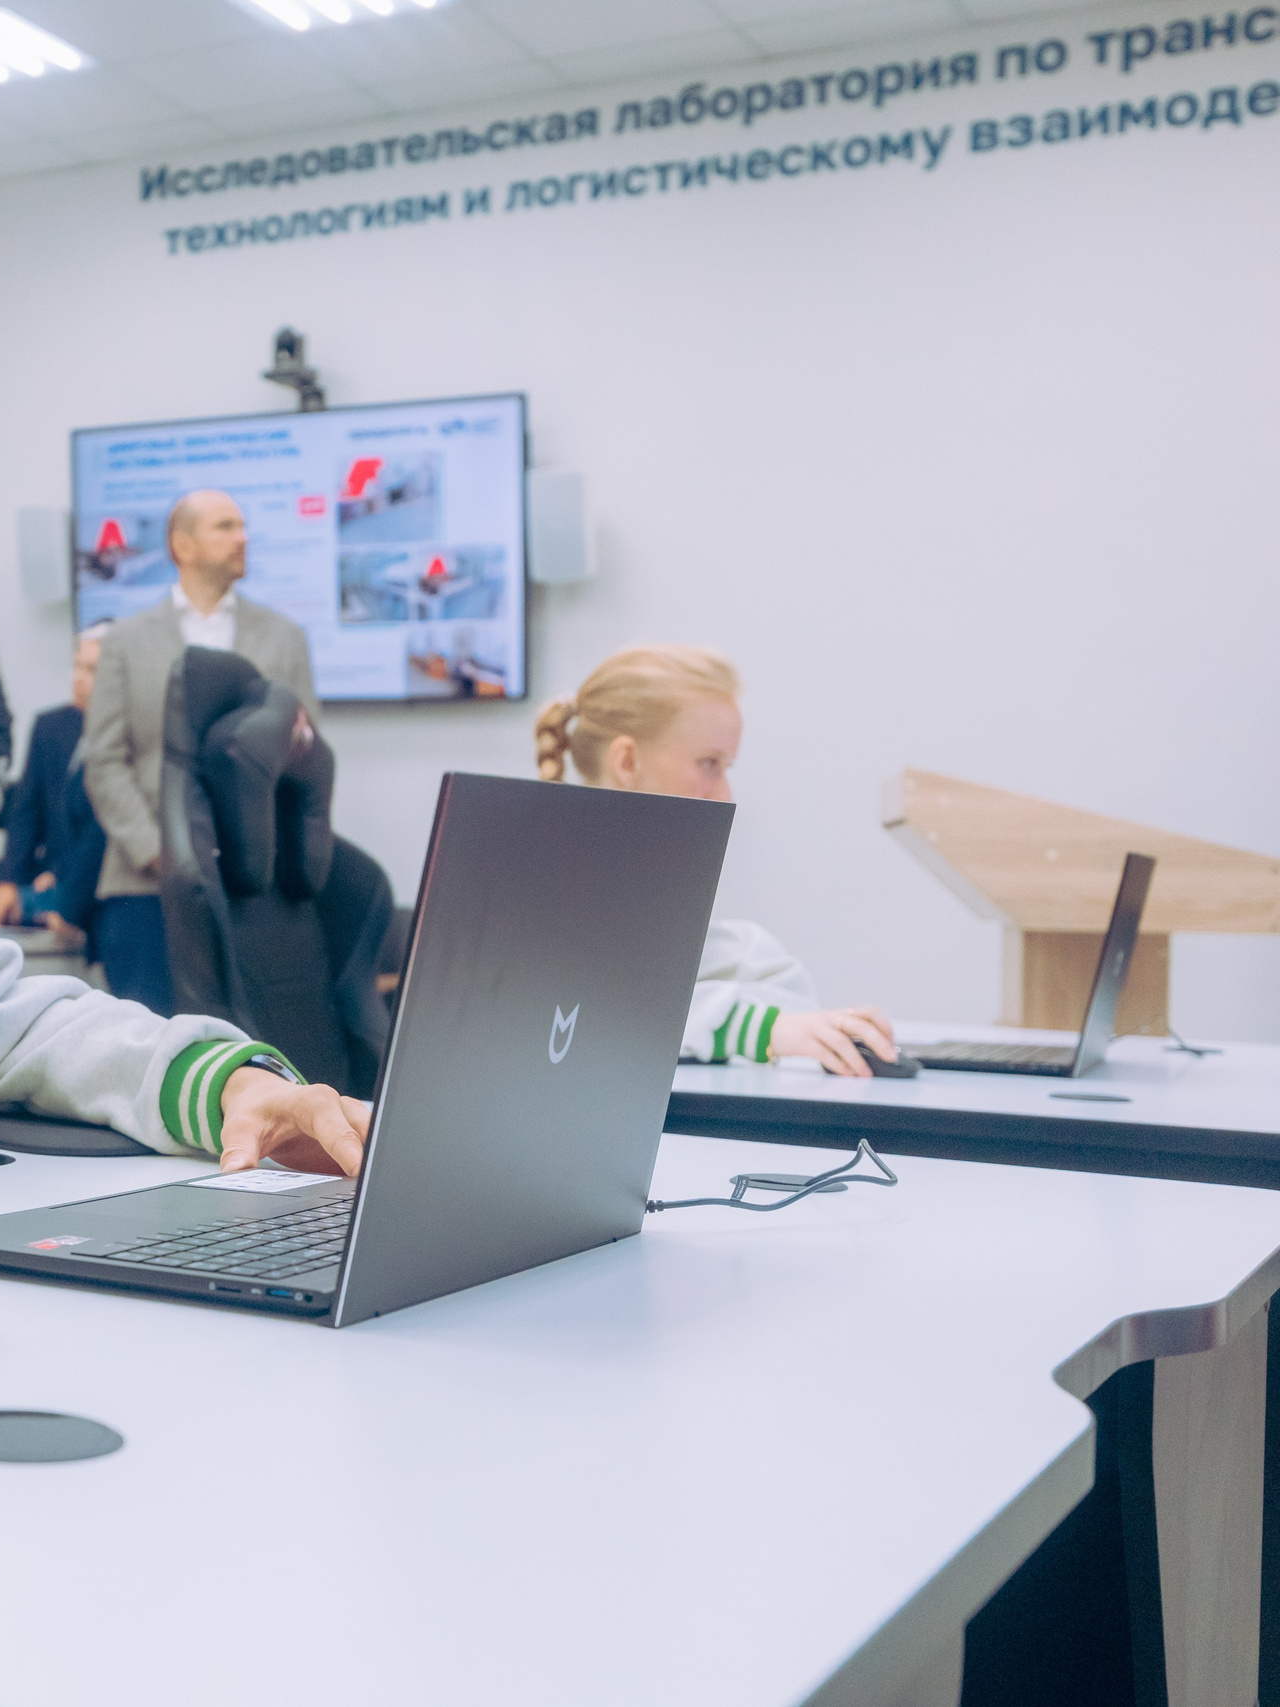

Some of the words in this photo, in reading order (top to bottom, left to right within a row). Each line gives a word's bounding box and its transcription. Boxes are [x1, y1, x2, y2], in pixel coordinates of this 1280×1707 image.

[139, 107, 600, 202] Исследовательская
[614, 51, 980, 133] лаборатория
[995, 38, 1069, 79] по
[1085, 5, 1280, 73] транс
[164, 192, 450, 255] технологиям
[463, 187, 491, 216] и
[505, 126, 952, 212] логистическому
[968, 81, 1280, 154] взаимоде
